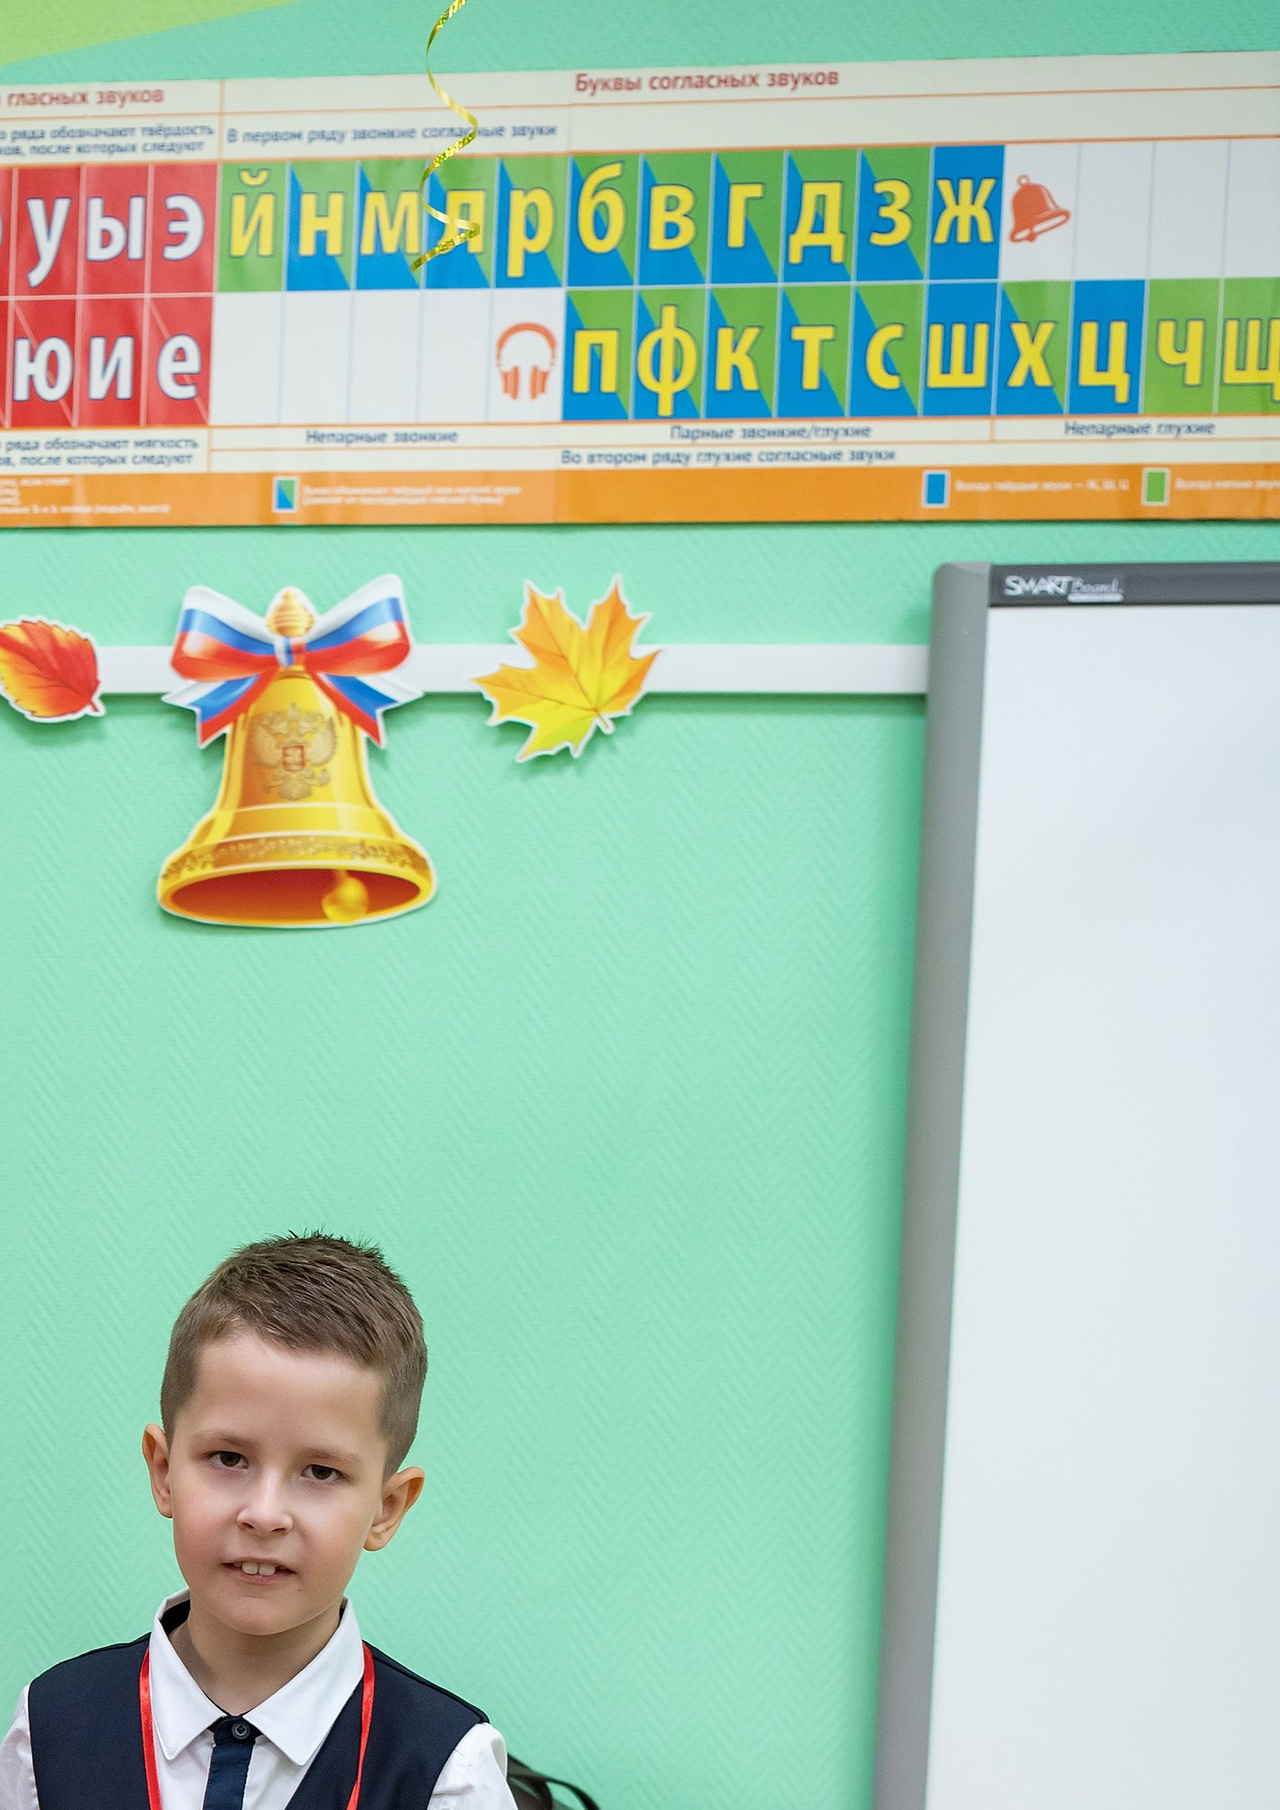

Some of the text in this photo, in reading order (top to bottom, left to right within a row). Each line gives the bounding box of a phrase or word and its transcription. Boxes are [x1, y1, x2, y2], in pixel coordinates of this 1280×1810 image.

[576, 69, 839, 96] Буквы согласных звуков
[7, 90, 89, 107] гласных
[96, 88, 164, 109] звуков
[227, 128, 237, 143] В
[306, 430, 387, 446] Непарные
[670, 424, 734, 442] Парные
[1064, 420, 1216, 438] Непарные глухие
[561, 449, 581, 465] Во
[652, 449, 690, 466] ряду
[1004, 574, 1072, 597] SMART
